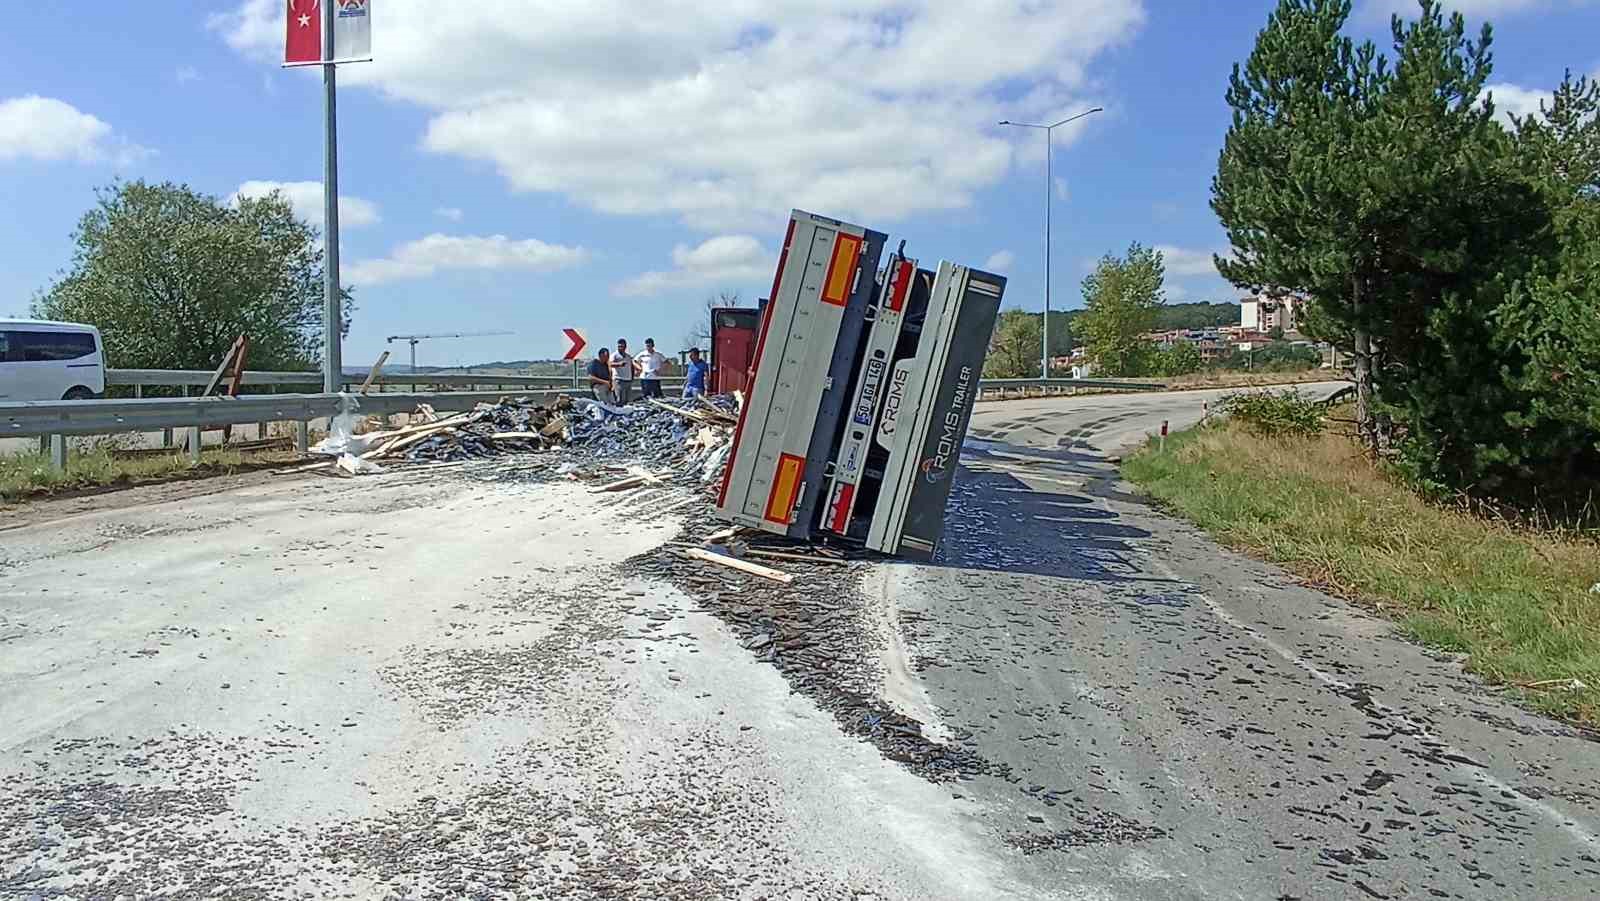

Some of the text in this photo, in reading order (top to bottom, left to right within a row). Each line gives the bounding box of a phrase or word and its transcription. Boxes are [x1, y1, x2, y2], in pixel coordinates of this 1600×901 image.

[858, 362, 881, 417] 50 AGA 146
[885, 369, 909, 421] ROMS
[934, 412, 959, 469] ROMS
[952, 366, 972, 409] TRAILER
